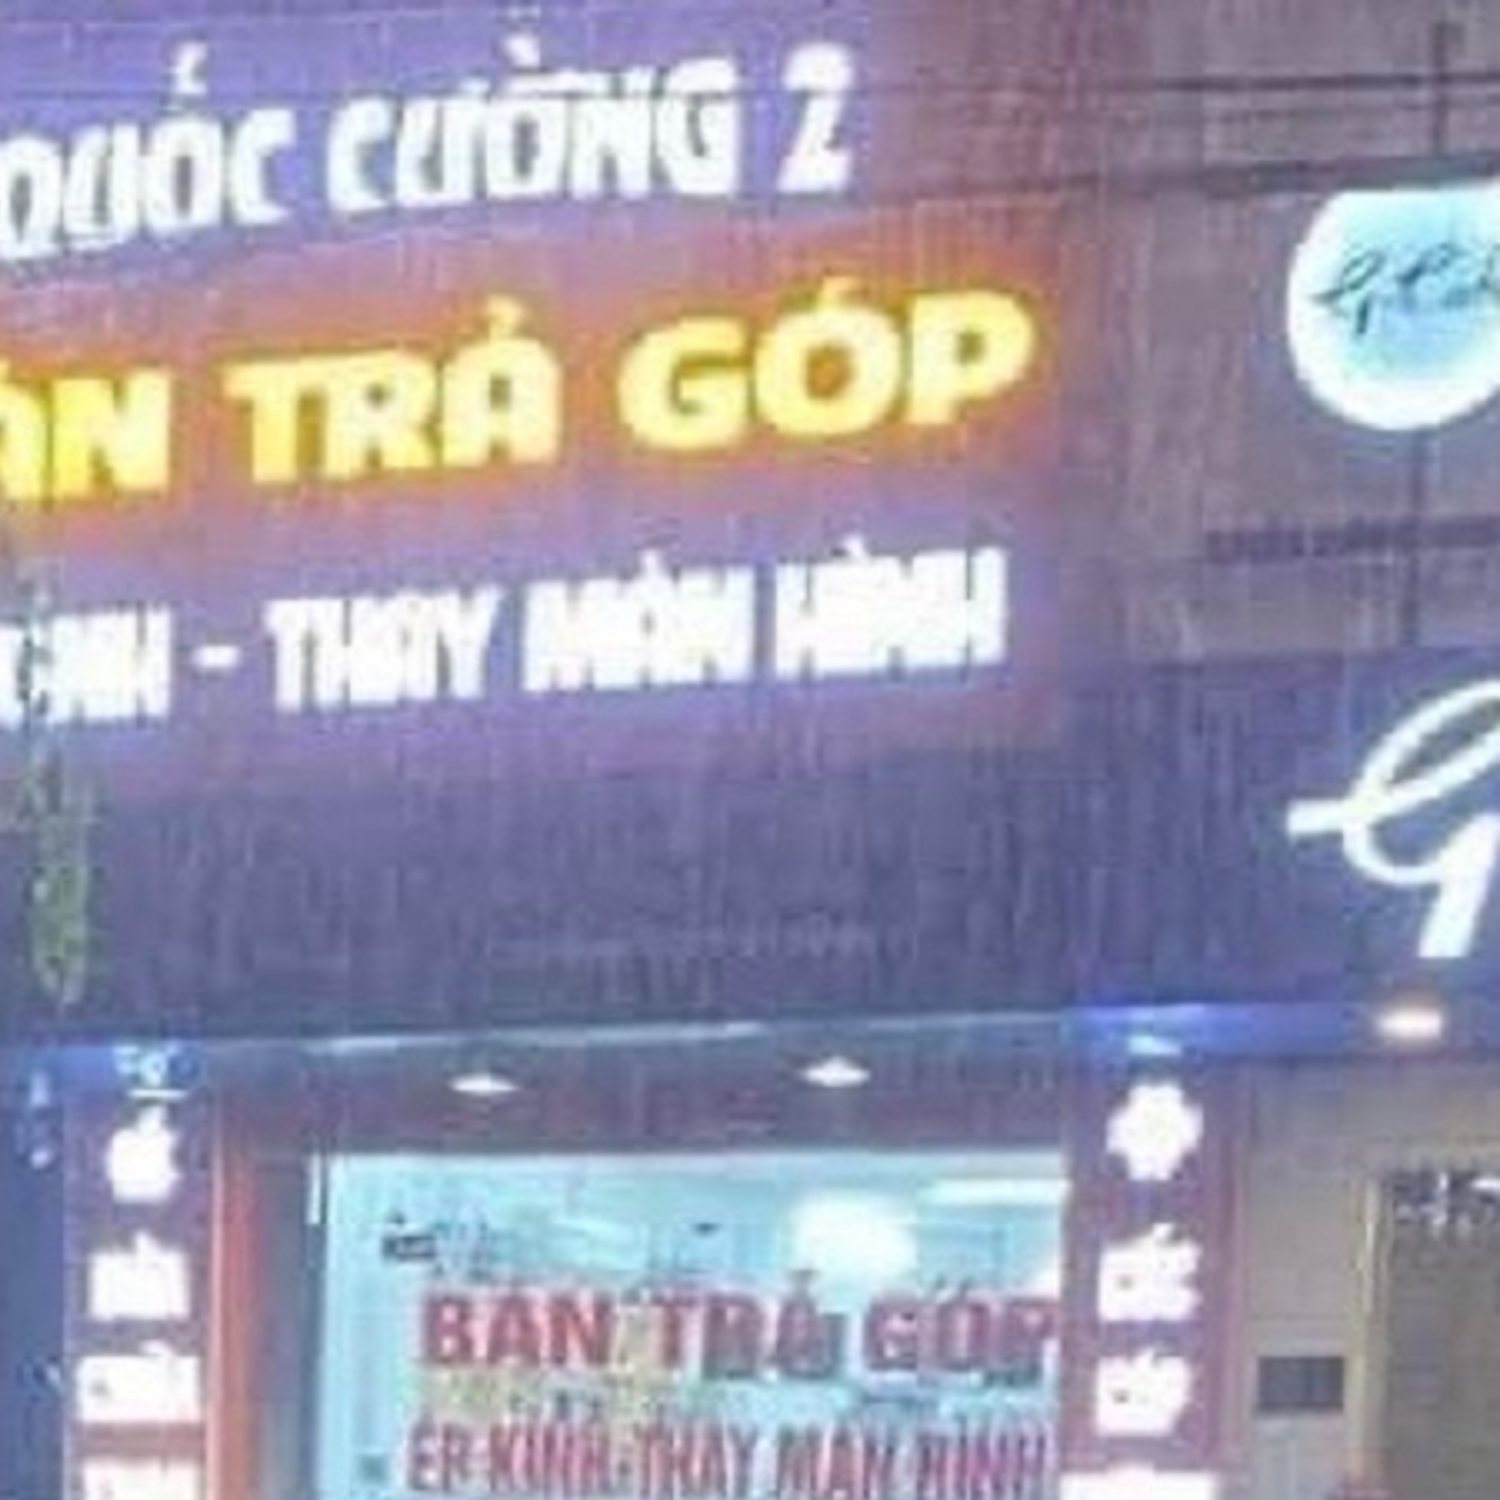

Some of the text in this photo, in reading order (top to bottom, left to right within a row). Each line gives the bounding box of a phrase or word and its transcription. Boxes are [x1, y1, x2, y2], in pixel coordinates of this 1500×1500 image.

[778, 42, 856, 196] 2
[222, 295, 562, 484] TRẢ
[613, 276, 1036, 450] GÓP
